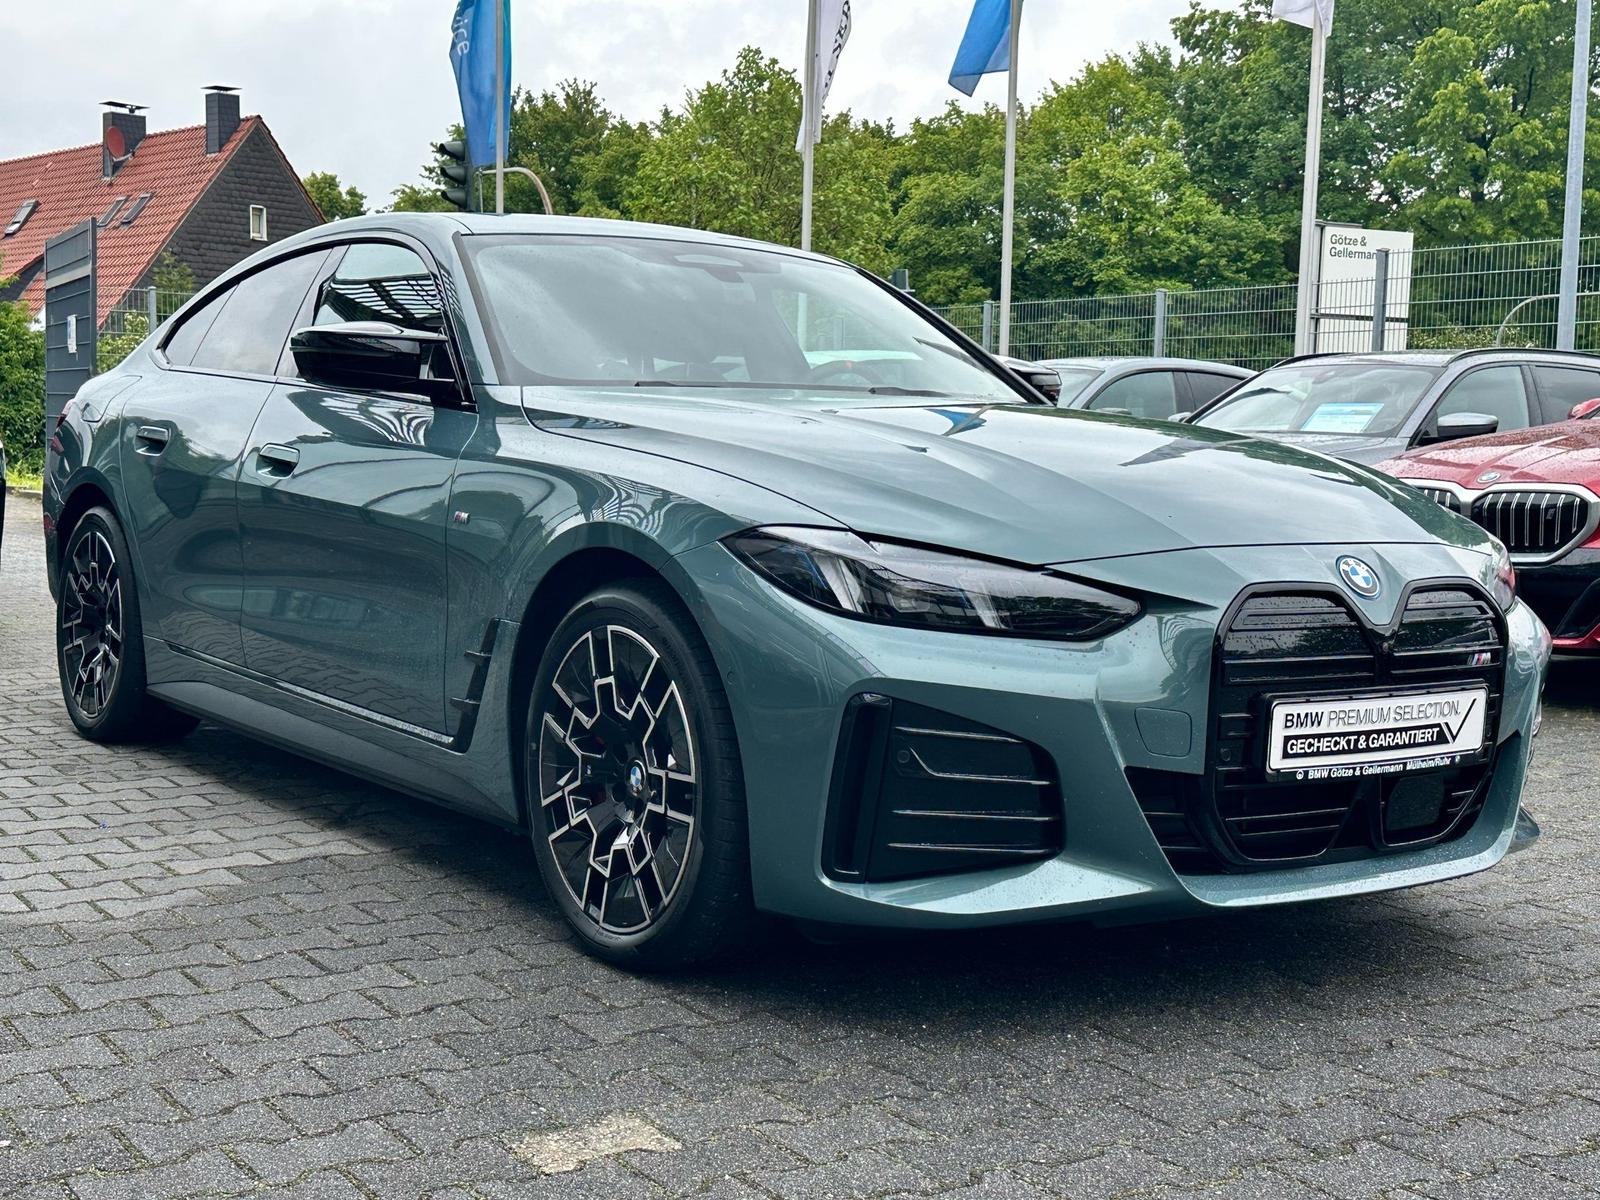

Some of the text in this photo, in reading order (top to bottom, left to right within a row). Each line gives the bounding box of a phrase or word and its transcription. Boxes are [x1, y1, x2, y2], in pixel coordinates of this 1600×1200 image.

[1330, 233, 1367, 246] Götze &
[1330, 246, 1376, 260] Gellerman
[1284, 711, 1324, 729] BMW
[1327, 706, 1391, 727] PREMIUM
[1287, 727, 1439, 754] GECHECKT & GARANTIERT
[1308, 768, 1329, 779] BMW
[1354, 766, 1361, 776] &
[1362, 763, 1403, 775] Gellermann
